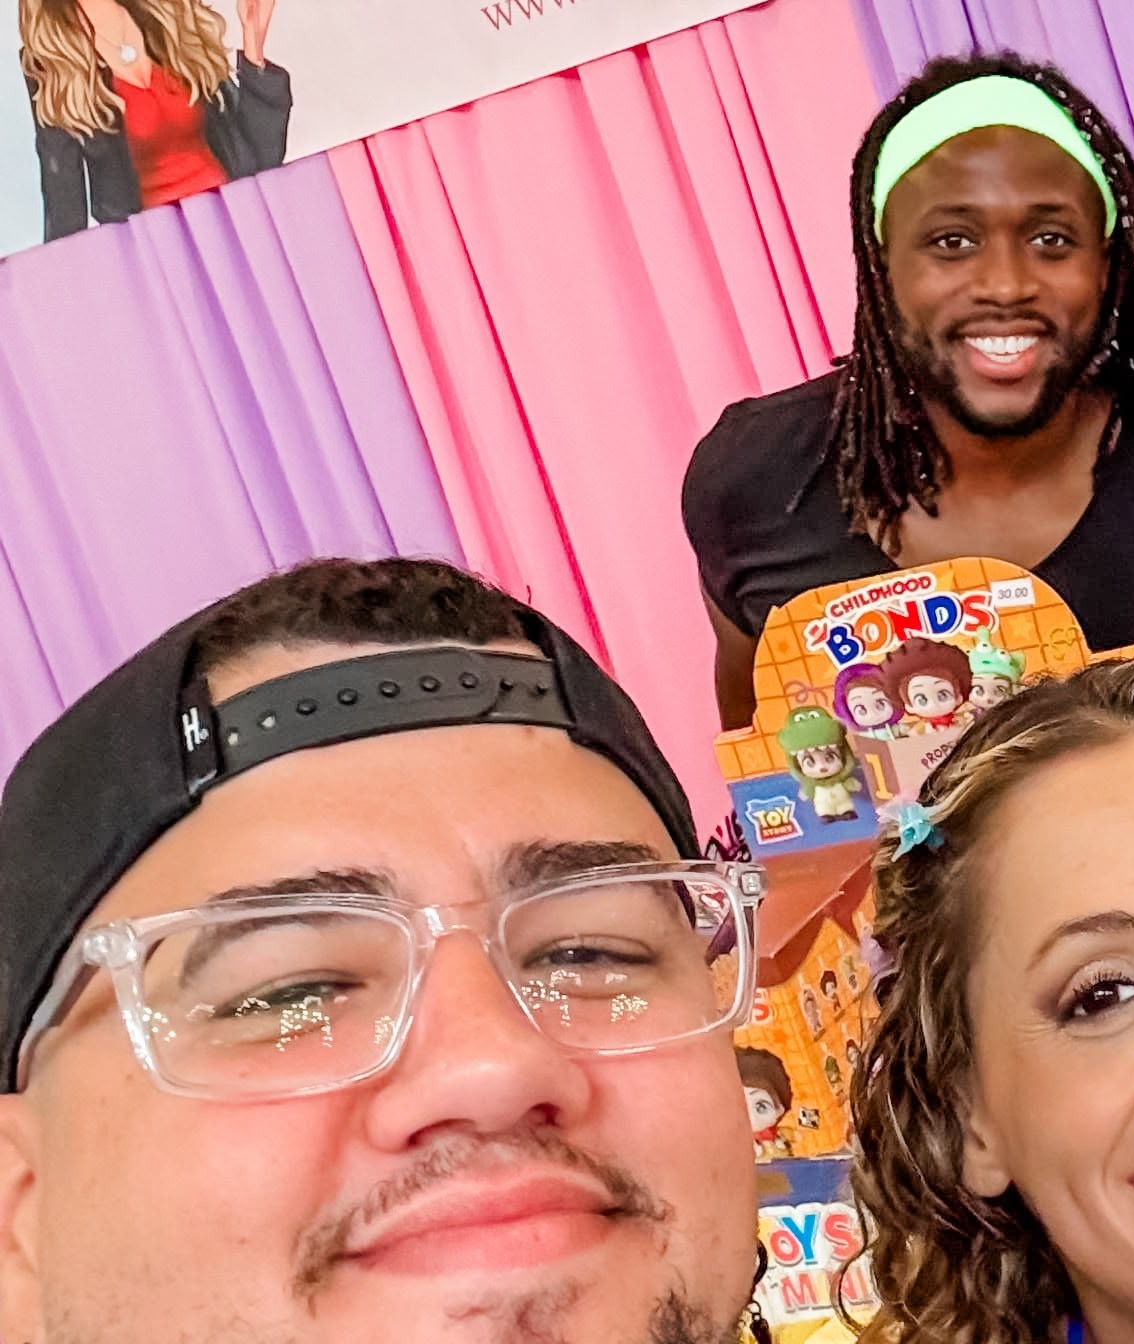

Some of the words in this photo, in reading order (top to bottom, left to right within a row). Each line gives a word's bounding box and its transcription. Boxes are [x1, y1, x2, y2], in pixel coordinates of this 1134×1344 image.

[829, 574, 934, 619] CHILDHOOD
[996, 586, 1030, 600] 30.00
[826, 594, 995, 666] BONDS
[754, 807, 792, 827] TOY
[764, 1212, 860, 1261] OYS
